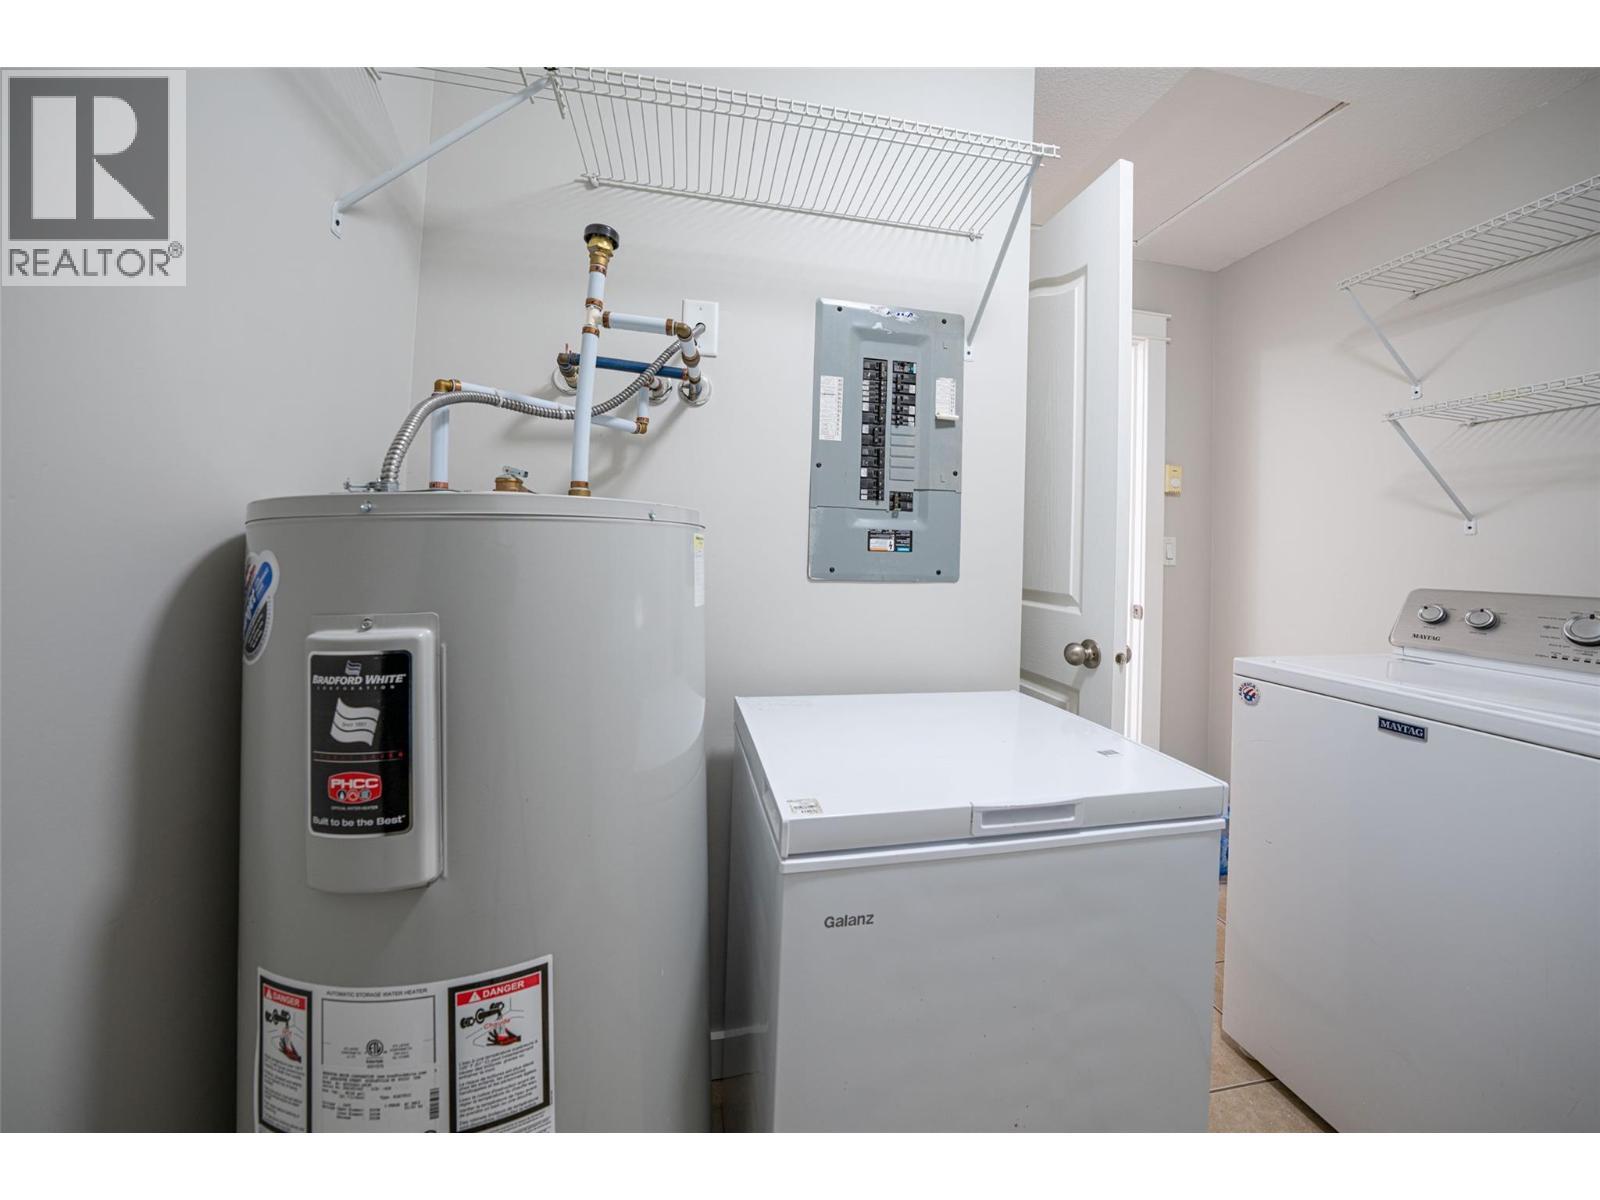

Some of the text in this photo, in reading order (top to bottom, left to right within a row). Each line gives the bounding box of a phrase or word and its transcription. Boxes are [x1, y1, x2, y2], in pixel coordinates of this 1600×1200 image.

[312, 675, 363, 685] BRADFORD
[1380, 720, 1424, 737] MAYTAG
[331, 778, 379, 789] PHCC
[330, 818, 340, 827] to
[342, 818, 355, 827] be
[357, 819, 374, 827] the
[824, 914, 874, 928] Galanz
[404, 987, 428, 995] HEATER
[482, 980, 525, 998] DANGER
